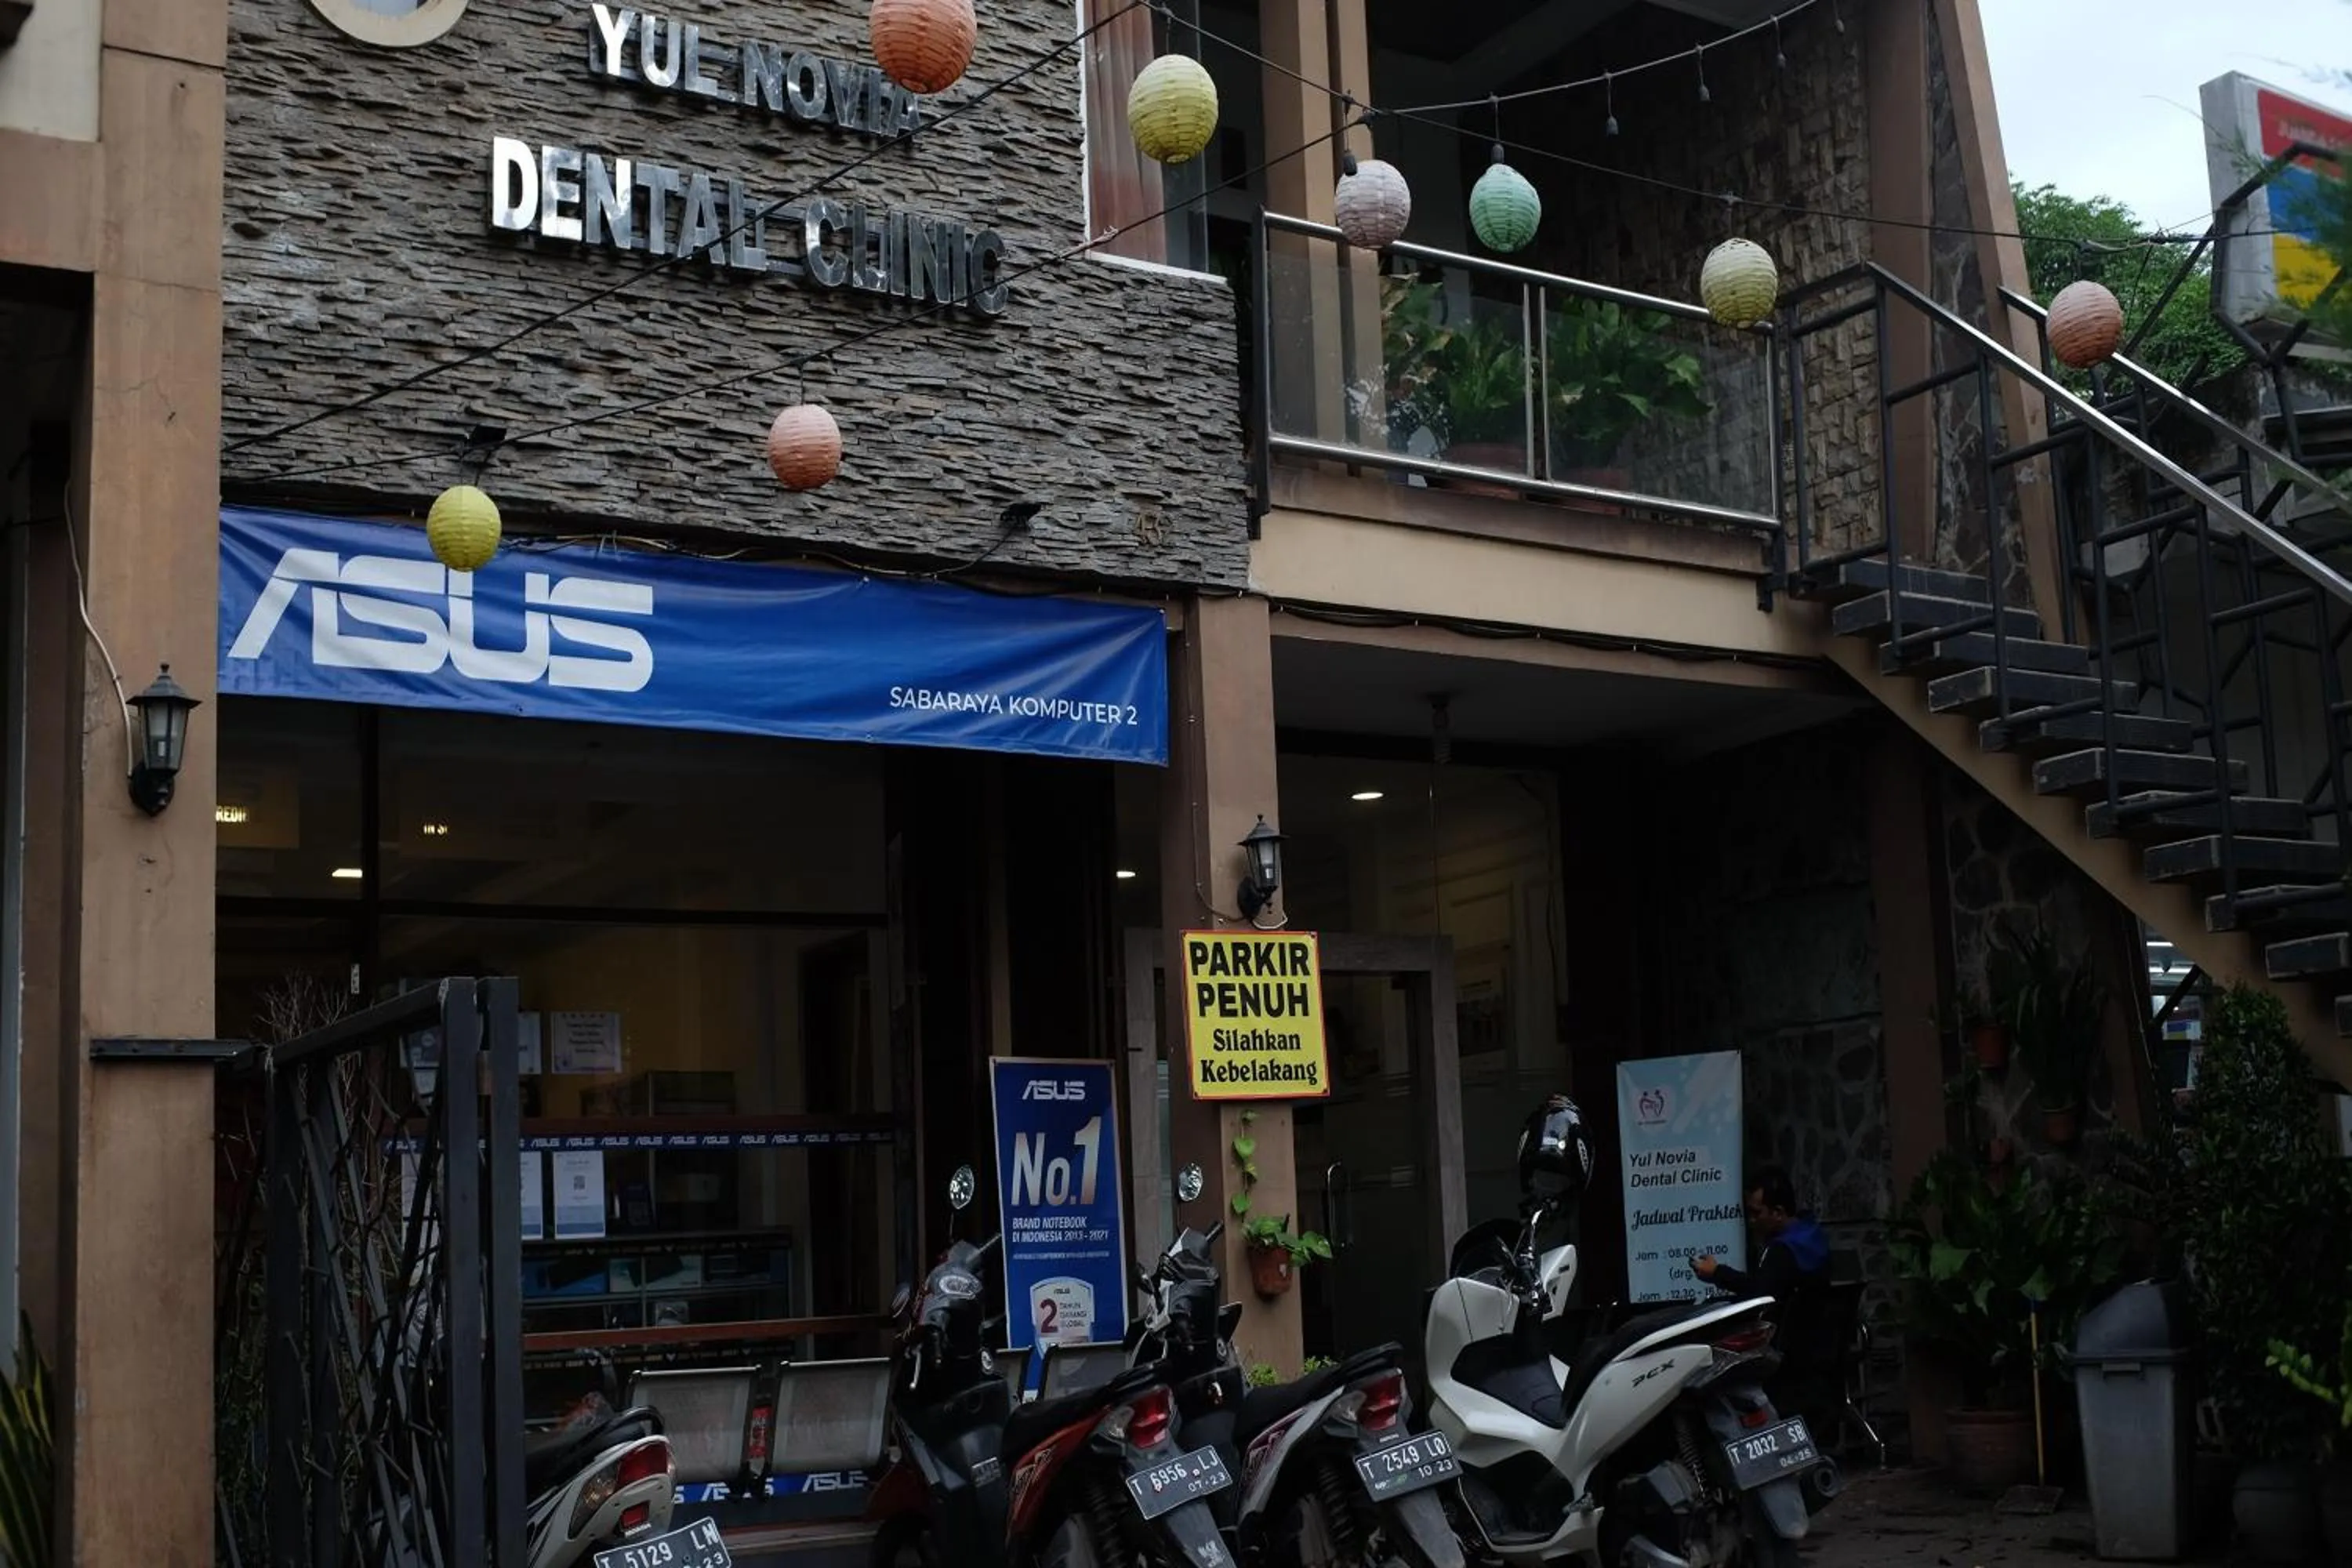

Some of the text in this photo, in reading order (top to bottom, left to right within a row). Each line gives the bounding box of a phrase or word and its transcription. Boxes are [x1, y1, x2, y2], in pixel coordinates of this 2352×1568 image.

[590, 3, 922, 138] YUL NOVIA
[492, 136, 1009, 314] DENTAL CLINIC
[227, 547, 653, 693] ASUS
[889, 685, 1138, 725] SABARAYA KOMPUTER 2
[1189, 941, 1311, 976] PARKIR
[1196, 982, 1309, 1017] PENUH
[1213, 1028, 1301, 1051] Silahkan
[1200, 1058, 1318, 1086] Kebelakang
[1022, 1079, 1087, 1101] ASUS
[1630, 1149, 1696, 1167] Yul Novia
[1630, 1167, 1722, 1188] Dental Clinic
[1012, 1216, 1087, 1230] BRAND NOTEBOOK
[1632, 1207, 1685, 1232] Jadwal
[1020, 1230, 1062, 1243] INDONESIA
[1040, 1298, 1058, 1334] 2
[1632, 1358, 1675, 1388] PCX
[1363, 1461, 1374, 1479] T
[1381, 1445, 1421, 1472] 2549
[1730, 1446, 1740, 1465] T
[1745, 1434, 1780, 1461] 2032
[801, 1469, 869, 1493] ASUS
[1131, 1478, 1142, 1495] T
[1149, 1463, 1188, 1490] 6956
[624, 1541, 673, 1568] 5129
